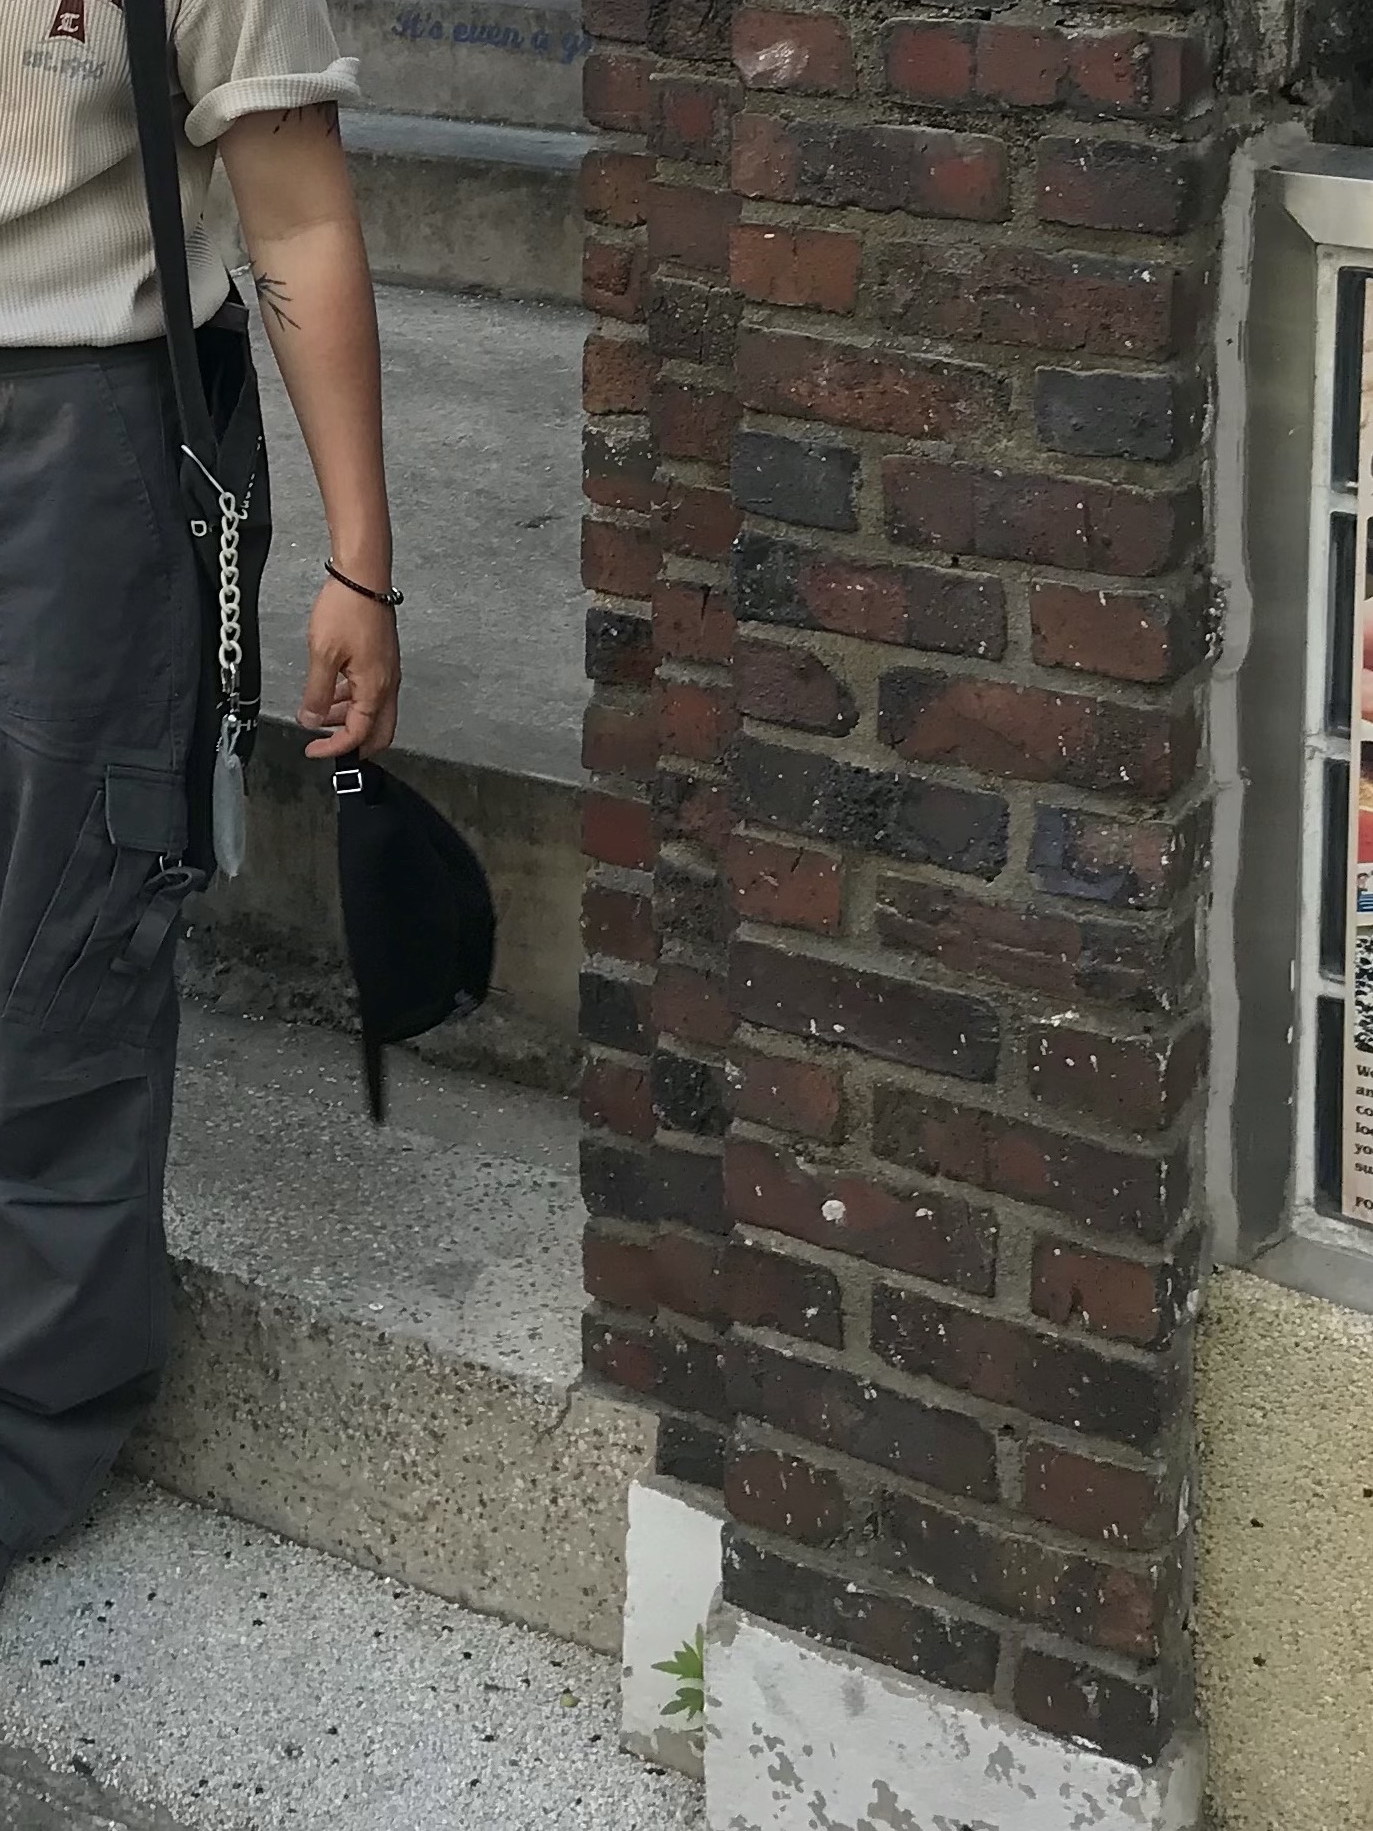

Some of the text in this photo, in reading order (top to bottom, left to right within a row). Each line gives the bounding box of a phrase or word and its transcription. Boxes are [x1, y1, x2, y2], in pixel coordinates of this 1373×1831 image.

[391, 7, 444, 40] It's
[453, 22, 525, 49] even
[531, 28, 550, 51] a
